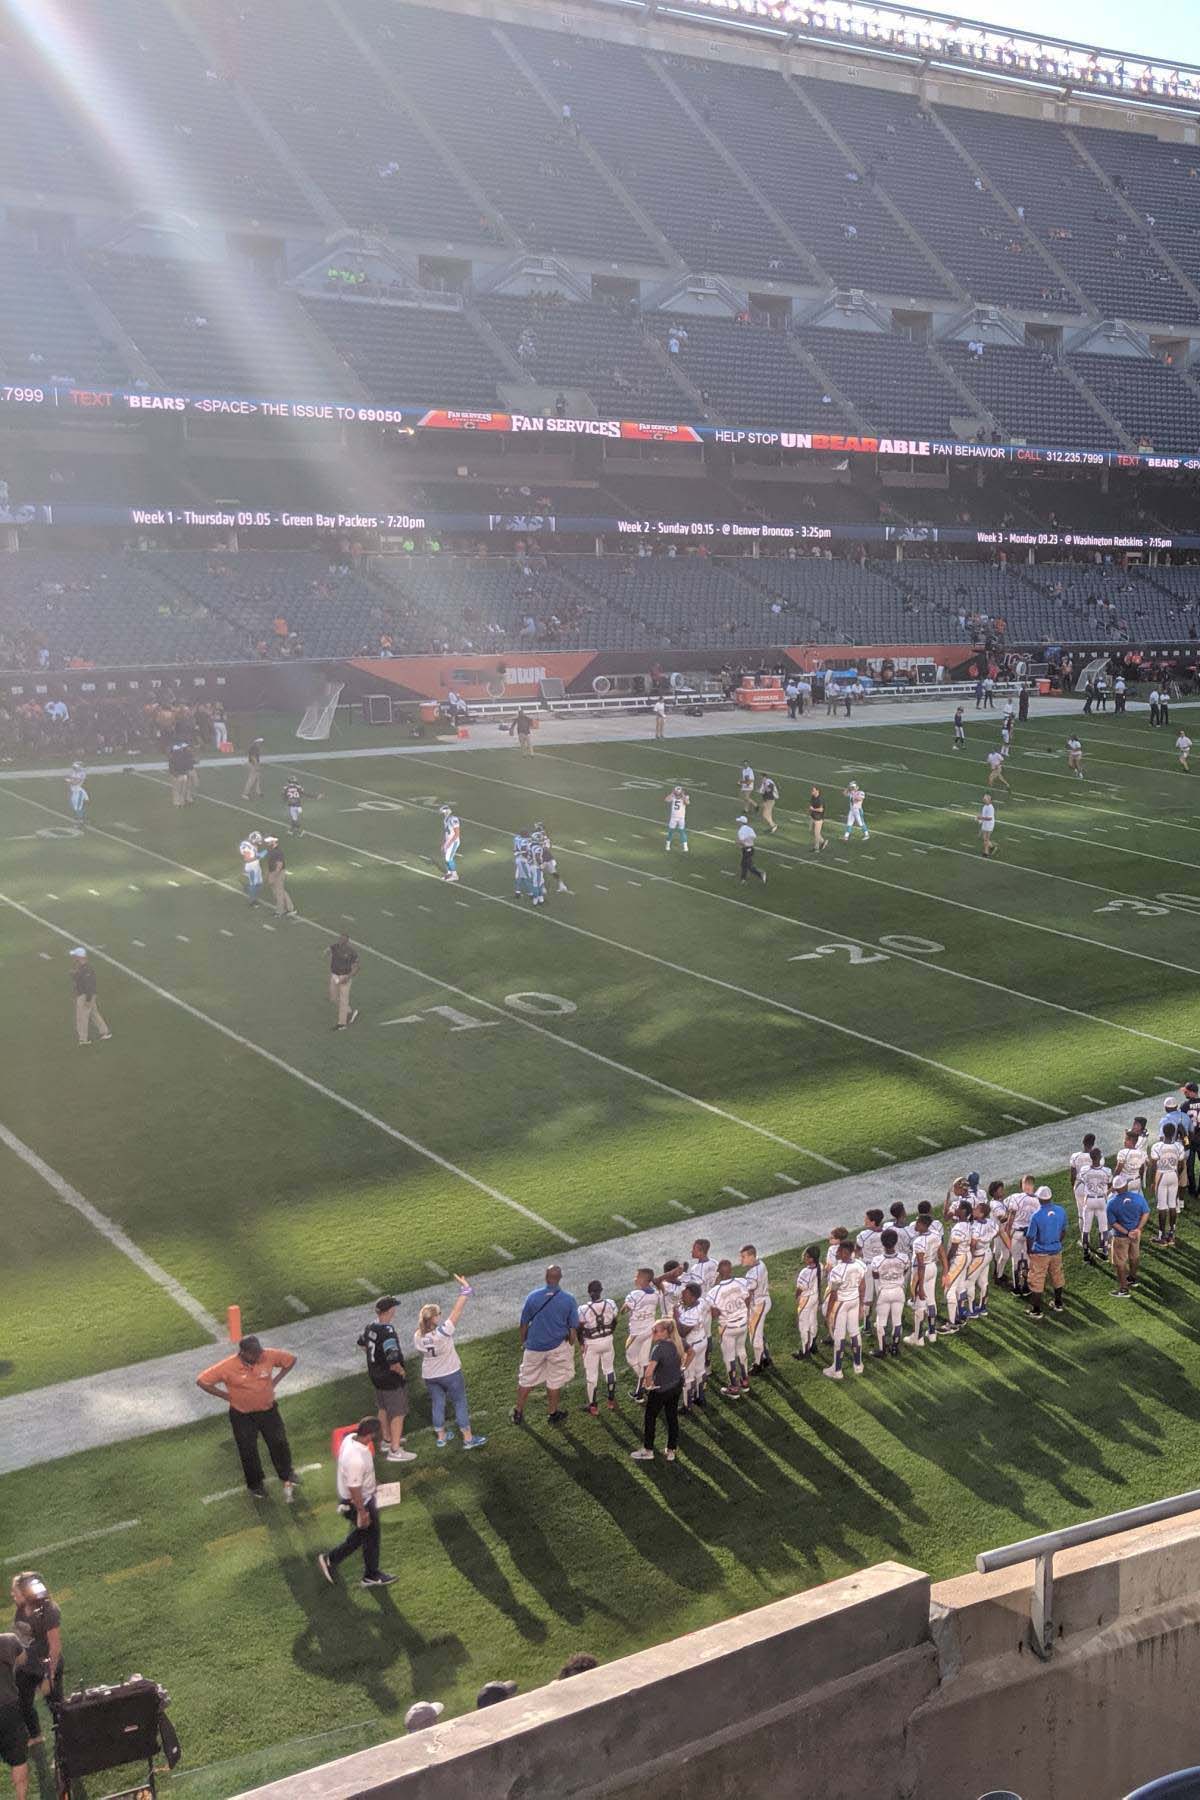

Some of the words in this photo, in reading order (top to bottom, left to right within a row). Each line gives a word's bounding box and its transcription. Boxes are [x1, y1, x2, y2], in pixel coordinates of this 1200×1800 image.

[70, 391, 112, 406] TEXT
[124, 394, 190, 410] "BEARS"
[195, 400, 258, 414] <SPACE>
[262, 402, 289, 416] THE
[292, 404, 334, 419] ISSUE
[336, 406, 355, 420] TO
[358, 408, 402, 423] 69050
[511, 415, 544, 433] FAN
[546, 418, 621, 438] SERVICES
[715, 430, 746, 445] HELP
[747, 431, 779, 446] STOP
[781, 433, 930, 456] UNBEARABLE
[933, 443, 953, 455] FAN
[955, 444, 1005, 459] BEHAVIOR
[1017, 448, 1041, 461] CALL
[1046, 451, 1104, 464] 312.235.7999
[1117, 454, 1140, 467] TEXT
[1145, 456, 1182, 468] "BEARS"
[133, 511, 165, 525] Week
[167, 511, 173, 525] 1
[184, 511, 235, 528] Thursday
[238, 513, 271, 526] 09.05
[282, 513, 313, 526] Green
[317, 514, 336, 528] Bay
[338, 515, 378, 528] Packers
[387, 516, 425, 529] 7:20pm
[618, 521, 642, 533] Week
[644, 522, 650, 533] 2
[658, 522, 688, 536] Sunday
[691, 523, 714, 535] 09.15
[722, 525, 731, 536] @
[732, 525, 760, 537] Denver
[762, 526, 794, 538] Broncos
[801, 527, 831, 540] 3:25pm
[977, 532, 997, 543] Week
[1009, 532, 1037, 546] Monday
[1038, 534, 1058, 545] 09.23
[1073, 535, 1112, 549] Washington
[1113, 536, 1143, 548] Redskins
[1149, 537, 1172, 550] 7:15pm
[673, 800, 681, 810] 5
[815, 934, 945, 965] 20
[422, 991, 578, 1032] 10
